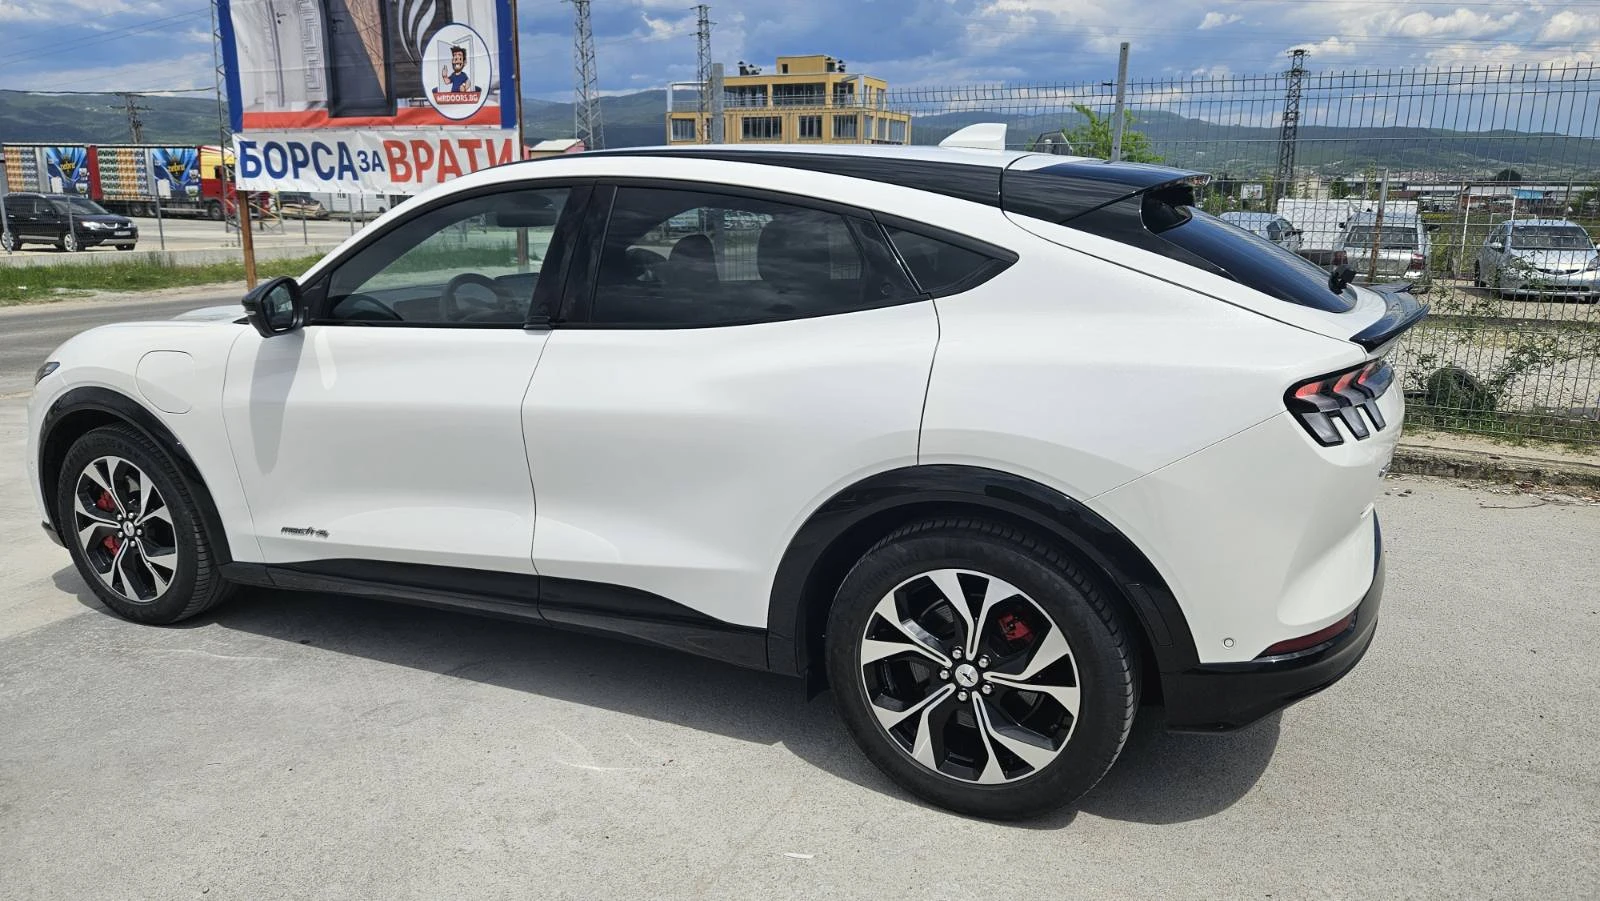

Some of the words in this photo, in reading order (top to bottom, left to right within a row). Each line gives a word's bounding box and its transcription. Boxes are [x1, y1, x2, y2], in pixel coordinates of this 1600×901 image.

[239, 140, 359, 181] БОРСА
[357, 150, 385, 173] ЗА
[383, 138, 513, 183] ВРАТИ
